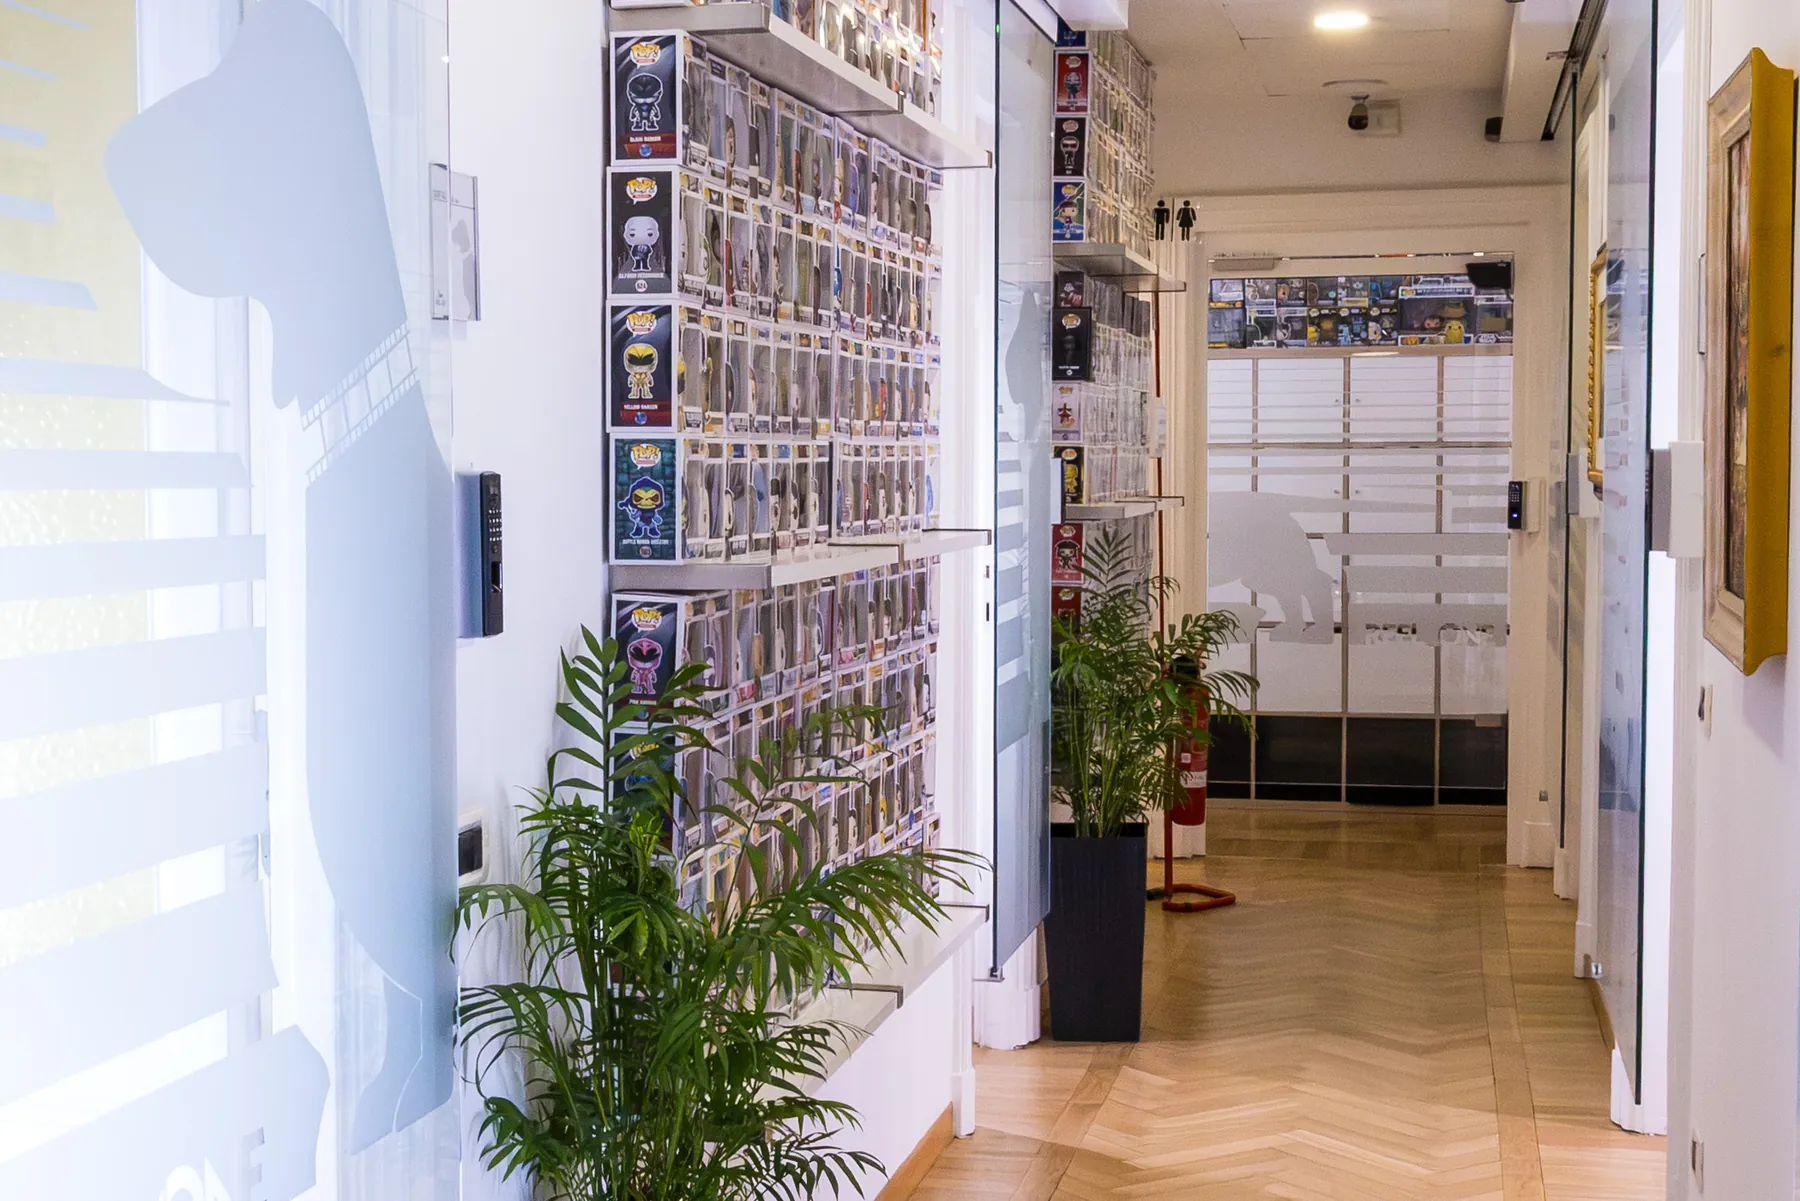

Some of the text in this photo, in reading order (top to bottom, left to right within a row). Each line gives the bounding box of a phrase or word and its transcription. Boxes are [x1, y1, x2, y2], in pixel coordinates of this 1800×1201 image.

[631, 43, 660, 58] POP!
[627, 179, 656, 194] POP!
[627, 312, 656, 327] POP!
[631, 445, 661, 460] POP!
[632, 608, 662, 624] POP!
